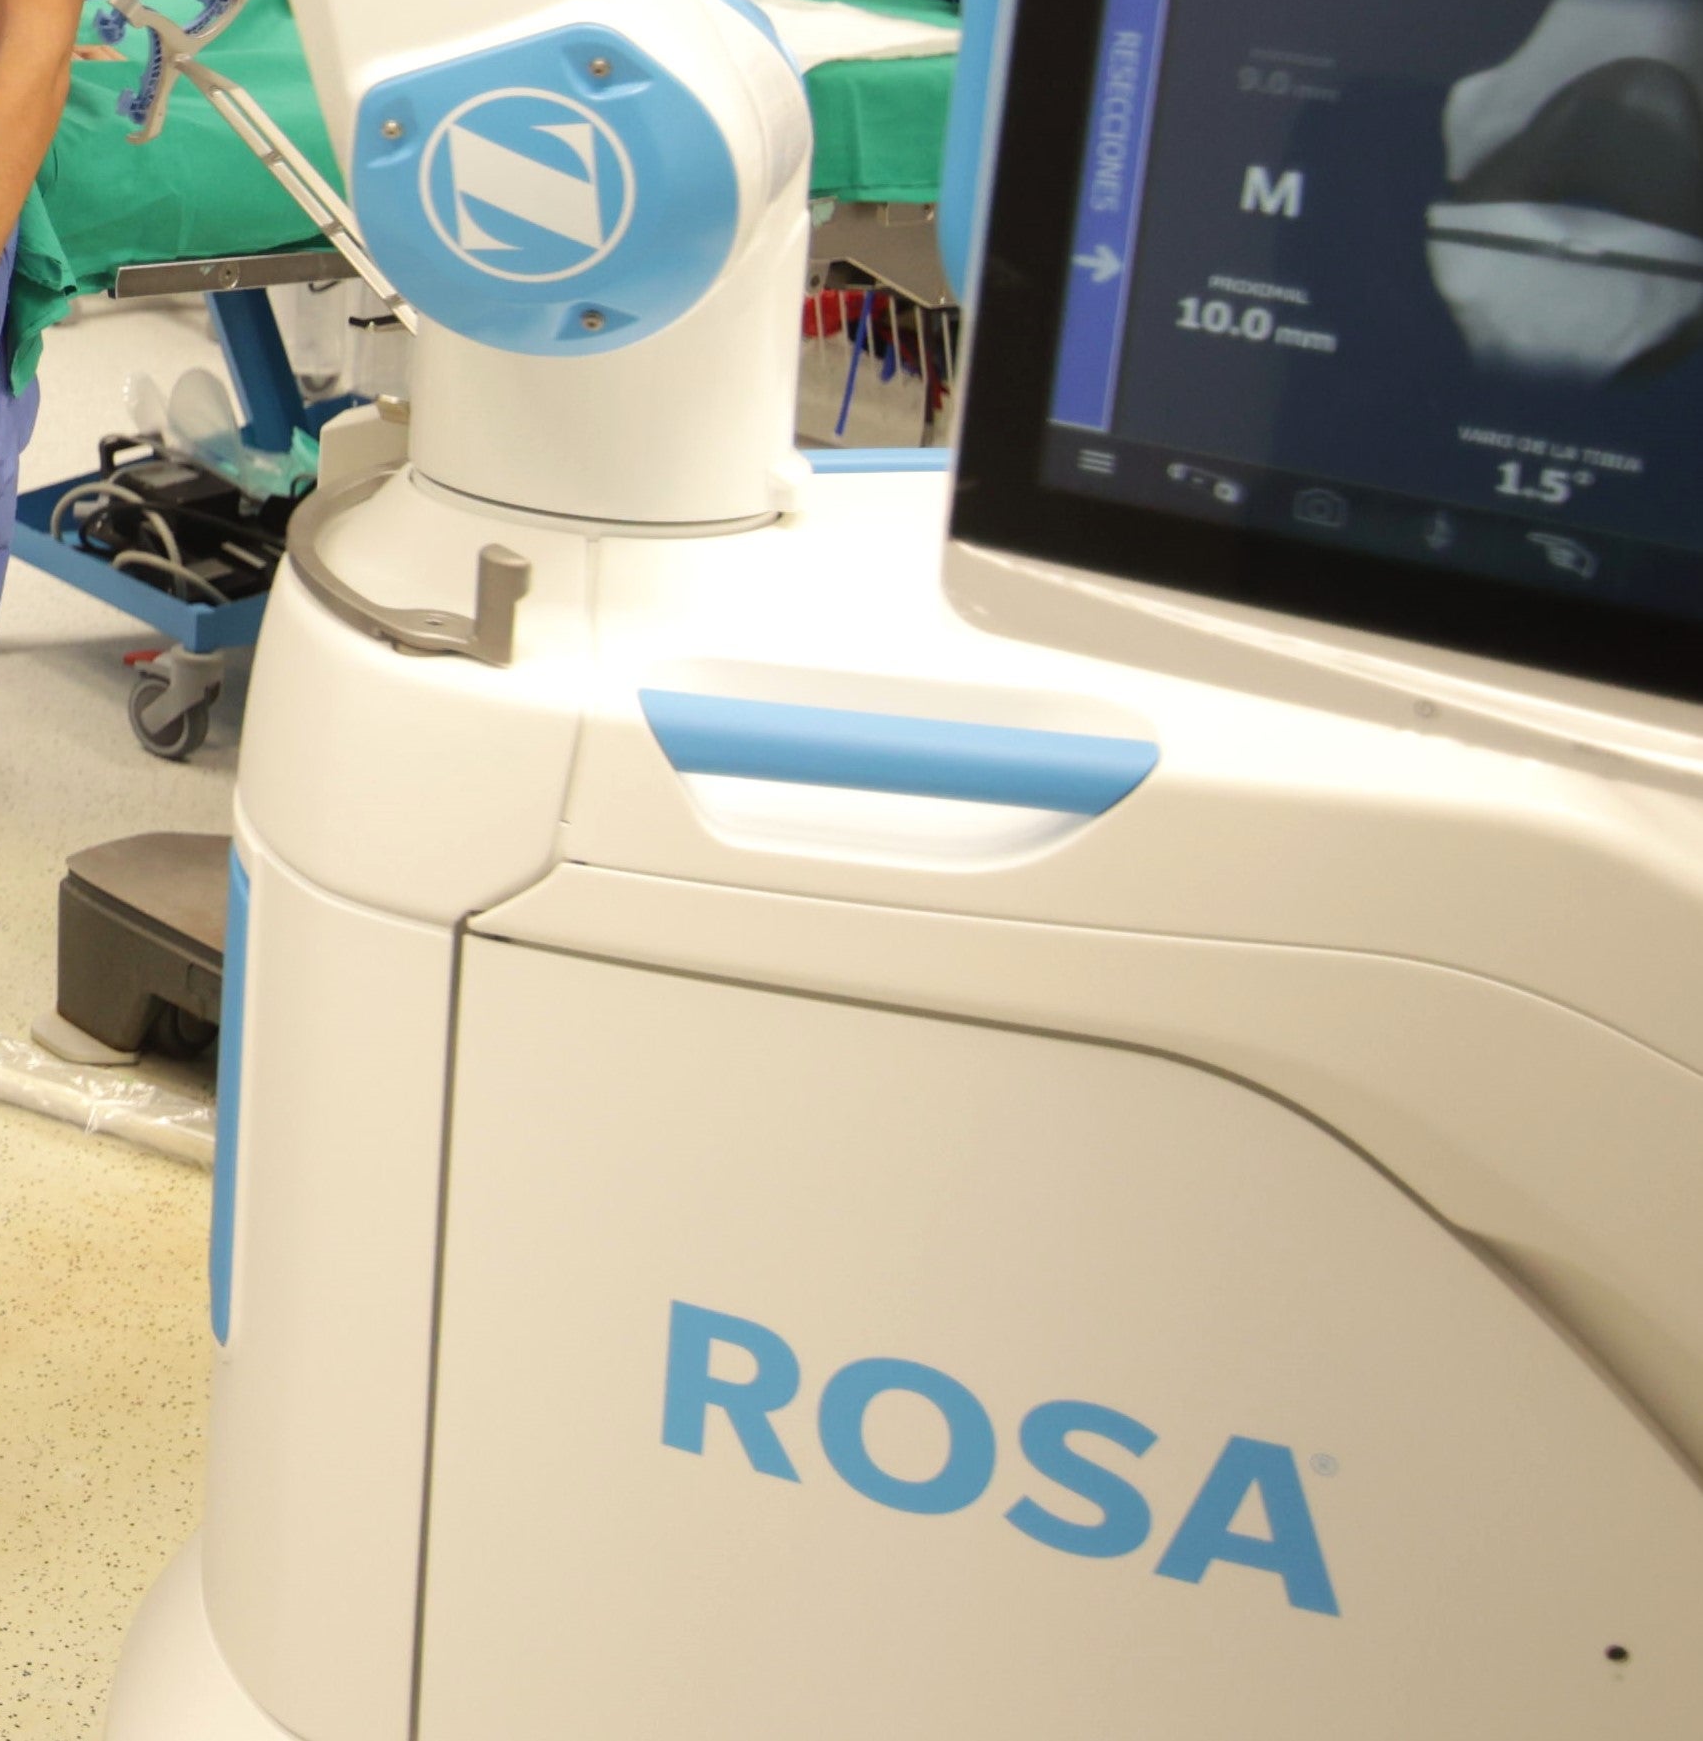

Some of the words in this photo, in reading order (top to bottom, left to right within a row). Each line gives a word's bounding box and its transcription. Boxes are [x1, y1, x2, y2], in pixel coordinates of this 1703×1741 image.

[1089, 29, 1142, 212] RESECCIONES
[1239, 166, 1303, 219] M
[1174, 295, 1274, 343] 10.0
[1274, 324, 1337, 354] mm
[661, 1299, 1342, 1618] ROSA
